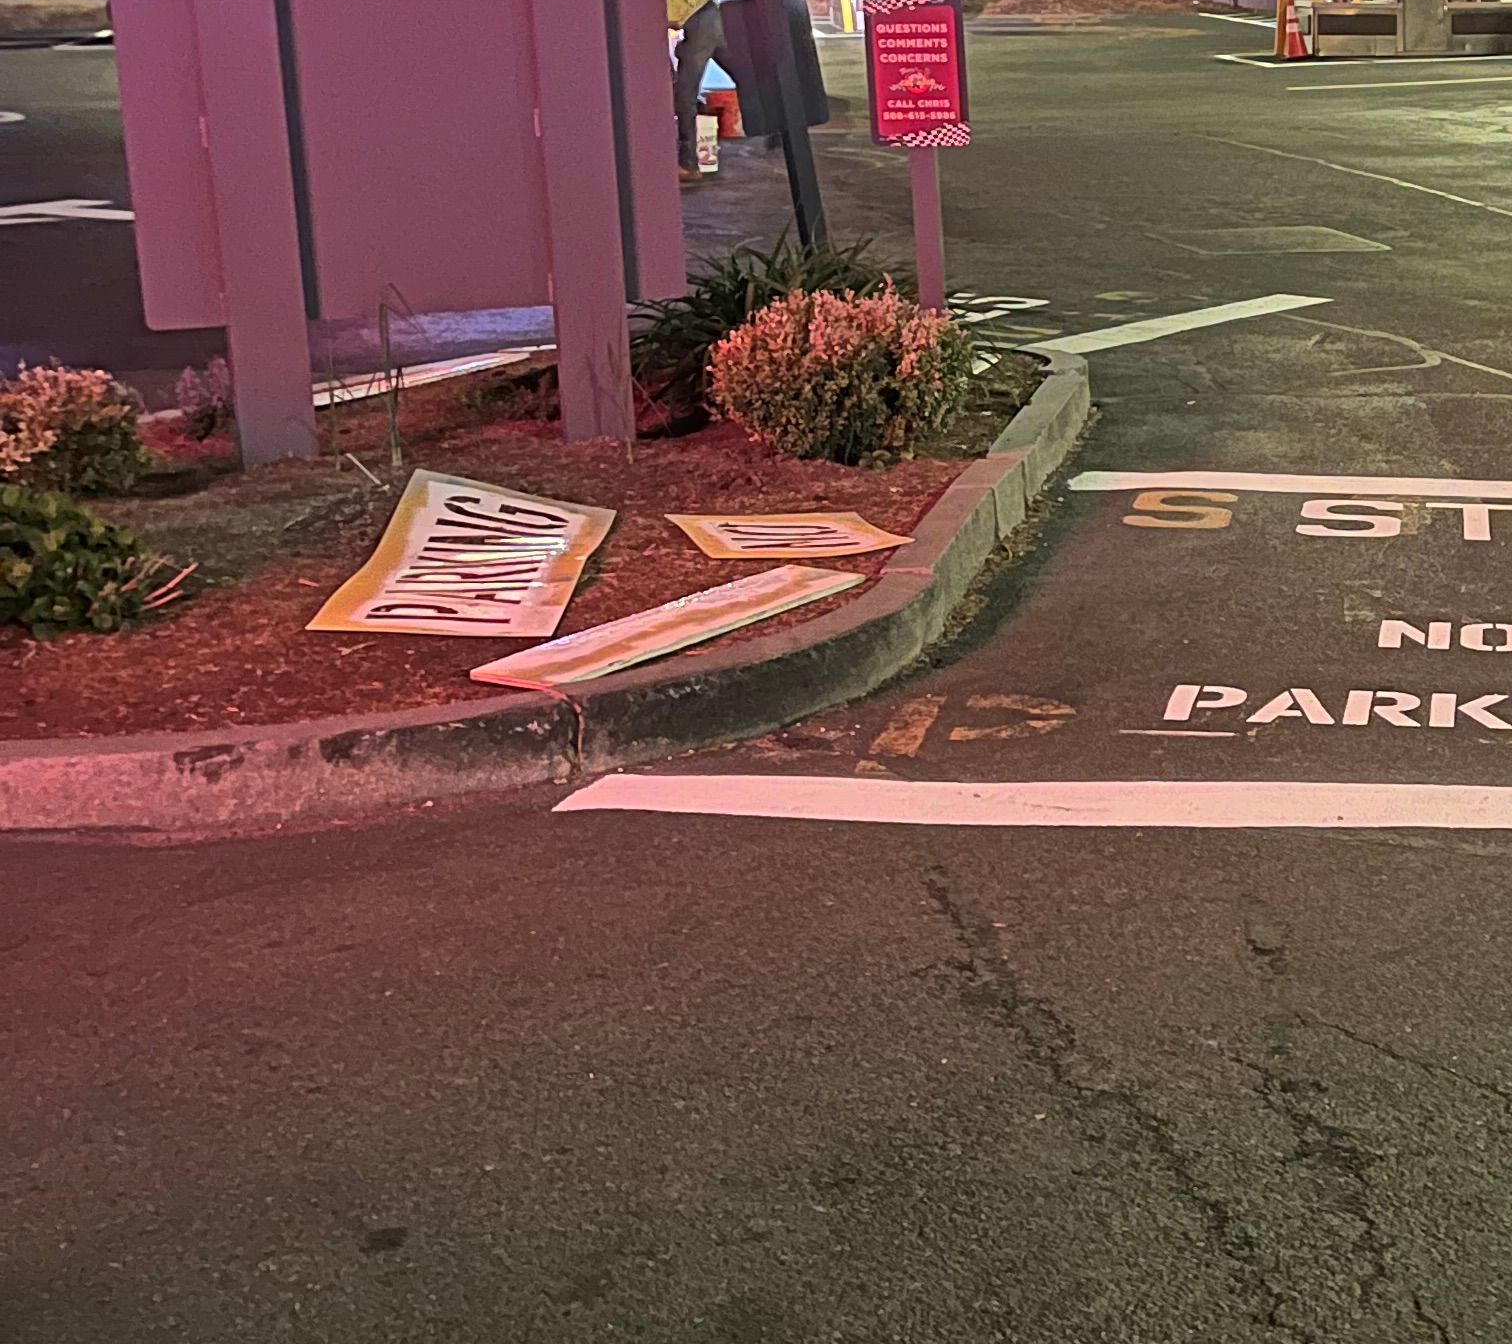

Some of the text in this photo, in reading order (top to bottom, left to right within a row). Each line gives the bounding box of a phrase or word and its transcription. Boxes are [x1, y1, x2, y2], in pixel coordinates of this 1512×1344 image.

[875, 23, 948, 34] QUESTIONS
[877, 38, 949, 49] COMMENTS
[879, 53, 949, 64] CONCERNS
[887, 99, 951, 108] CALL CHRIS
